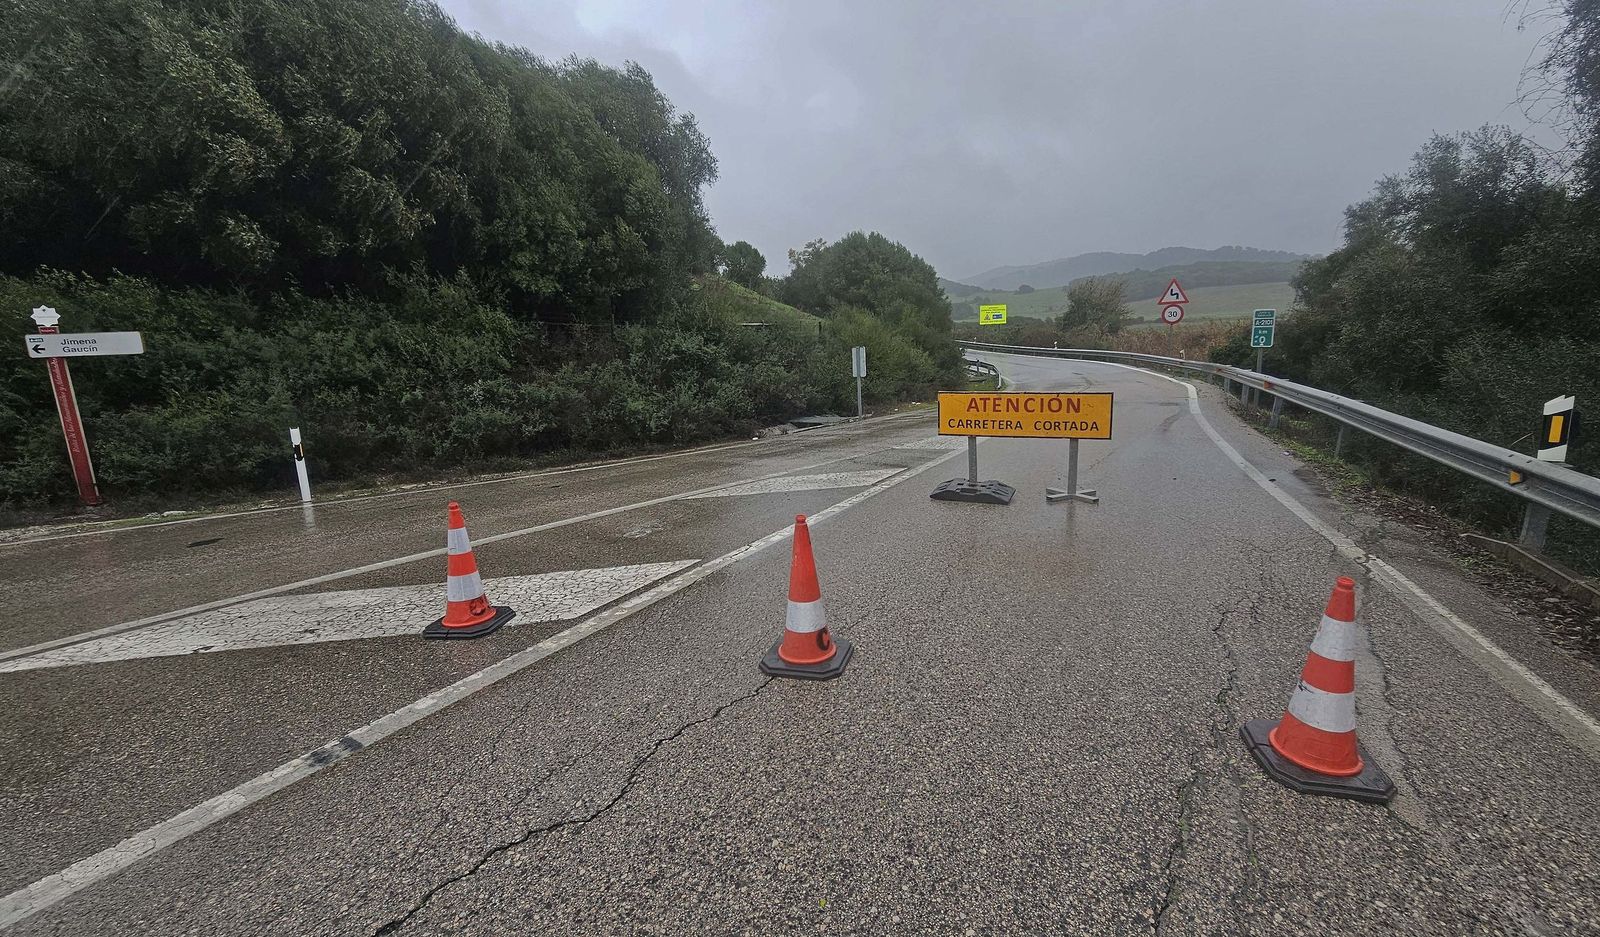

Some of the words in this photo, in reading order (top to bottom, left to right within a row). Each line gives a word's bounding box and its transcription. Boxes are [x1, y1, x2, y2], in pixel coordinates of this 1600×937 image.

[966, 394, 1080, 414] ATENCIÓN
[948, 418, 1023, 430] CARRETERA
[1034, 421, 1099, 431] CORTADA
